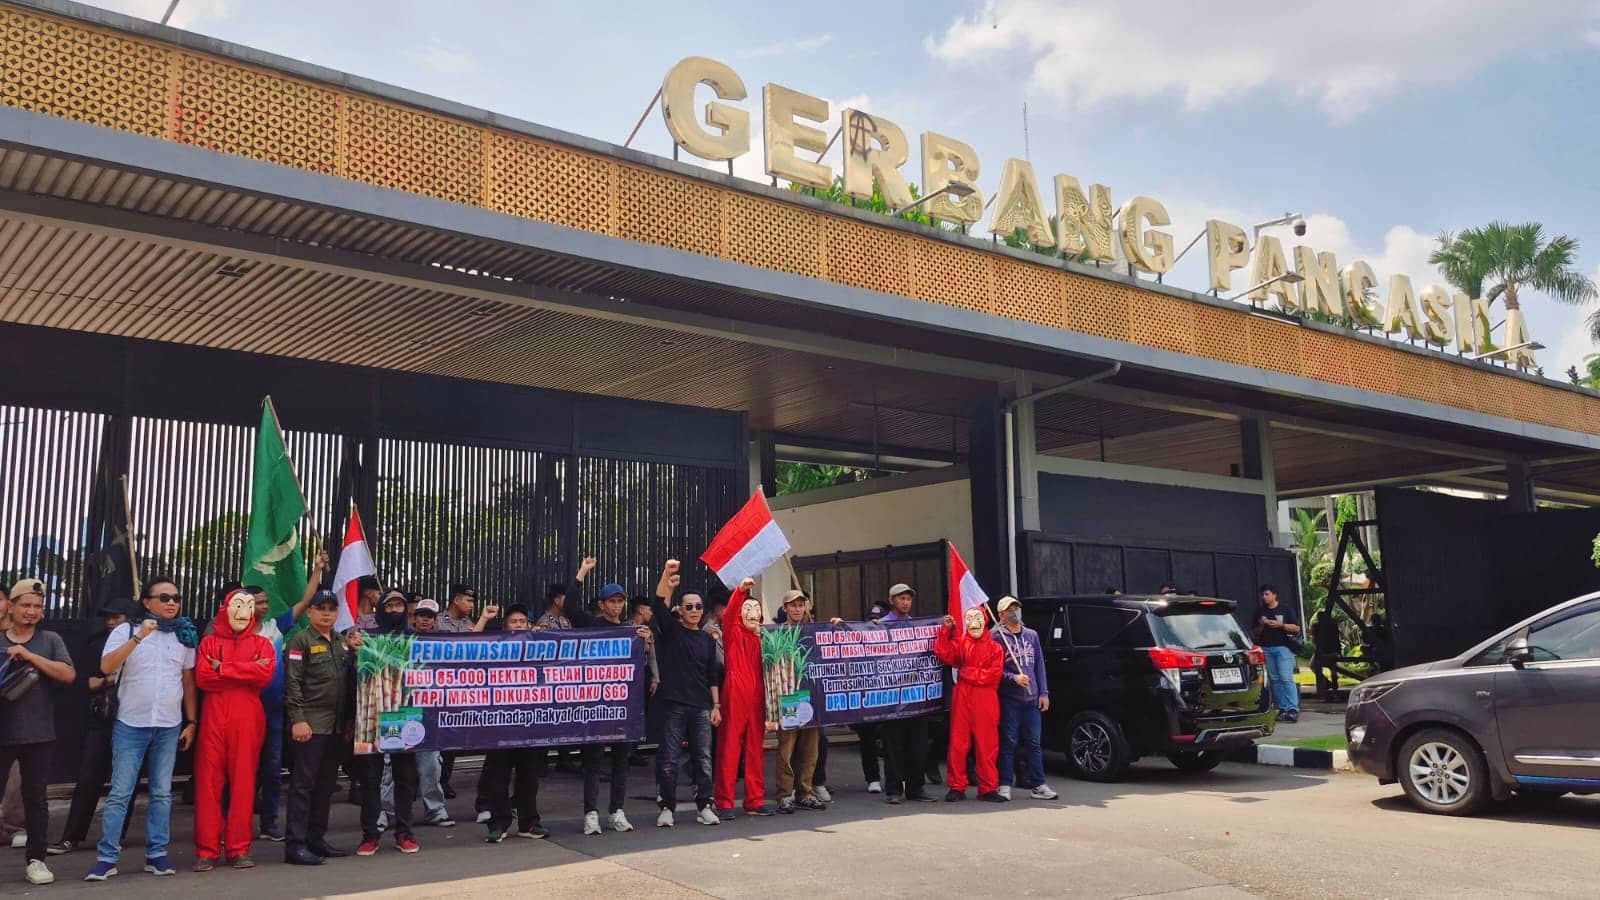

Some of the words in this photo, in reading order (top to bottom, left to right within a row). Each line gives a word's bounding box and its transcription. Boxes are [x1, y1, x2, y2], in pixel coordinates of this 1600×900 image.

[661, 56, 1177, 273] GERBANG
[1206, 219, 1537, 368] PANCASILA
[815, 631, 832, 645] HGU
[411, 640, 521, 662] PENGAWASAN
[525, 641, 557, 661] DPR
[560, 640, 577, 660] RI
[580, 638, 632, 659] LEMAH
[406, 669, 433, 687] HGU
[436, 668, 486, 686] 85.000
[488, 667, 536, 685] HEKTAR
[544, 666, 583, 684] TELAH
[586, 664, 634, 682] DICABUT
[809, 662, 846, 679] HITUNGAN
[849, 661, 875, 676] RAKYAT
[877, 659, 892, 674] SGC
[412, 689, 444, 707] TAPI
[448, 688, 490, 706] MASIH
[494, 686, 553, 705] DIKUASAI
[555, 684, 602, 703] GULAKU
[603, 683, 628, 701] SGC
[824, 676, 864, 692] Termasuk
[864, 675, 879, 690] hak
[825, 693, 847, 711] DPR
[863, 688, 900, 708] JANGAN
[901, 685, 926, 704] MATI
[438, 711, 481, 728] Konflik
[482, 709, 533, 727] terhadap
[535, 708, 571, 725] Rakyat
[573, 705, 626, 724] dipelihara
